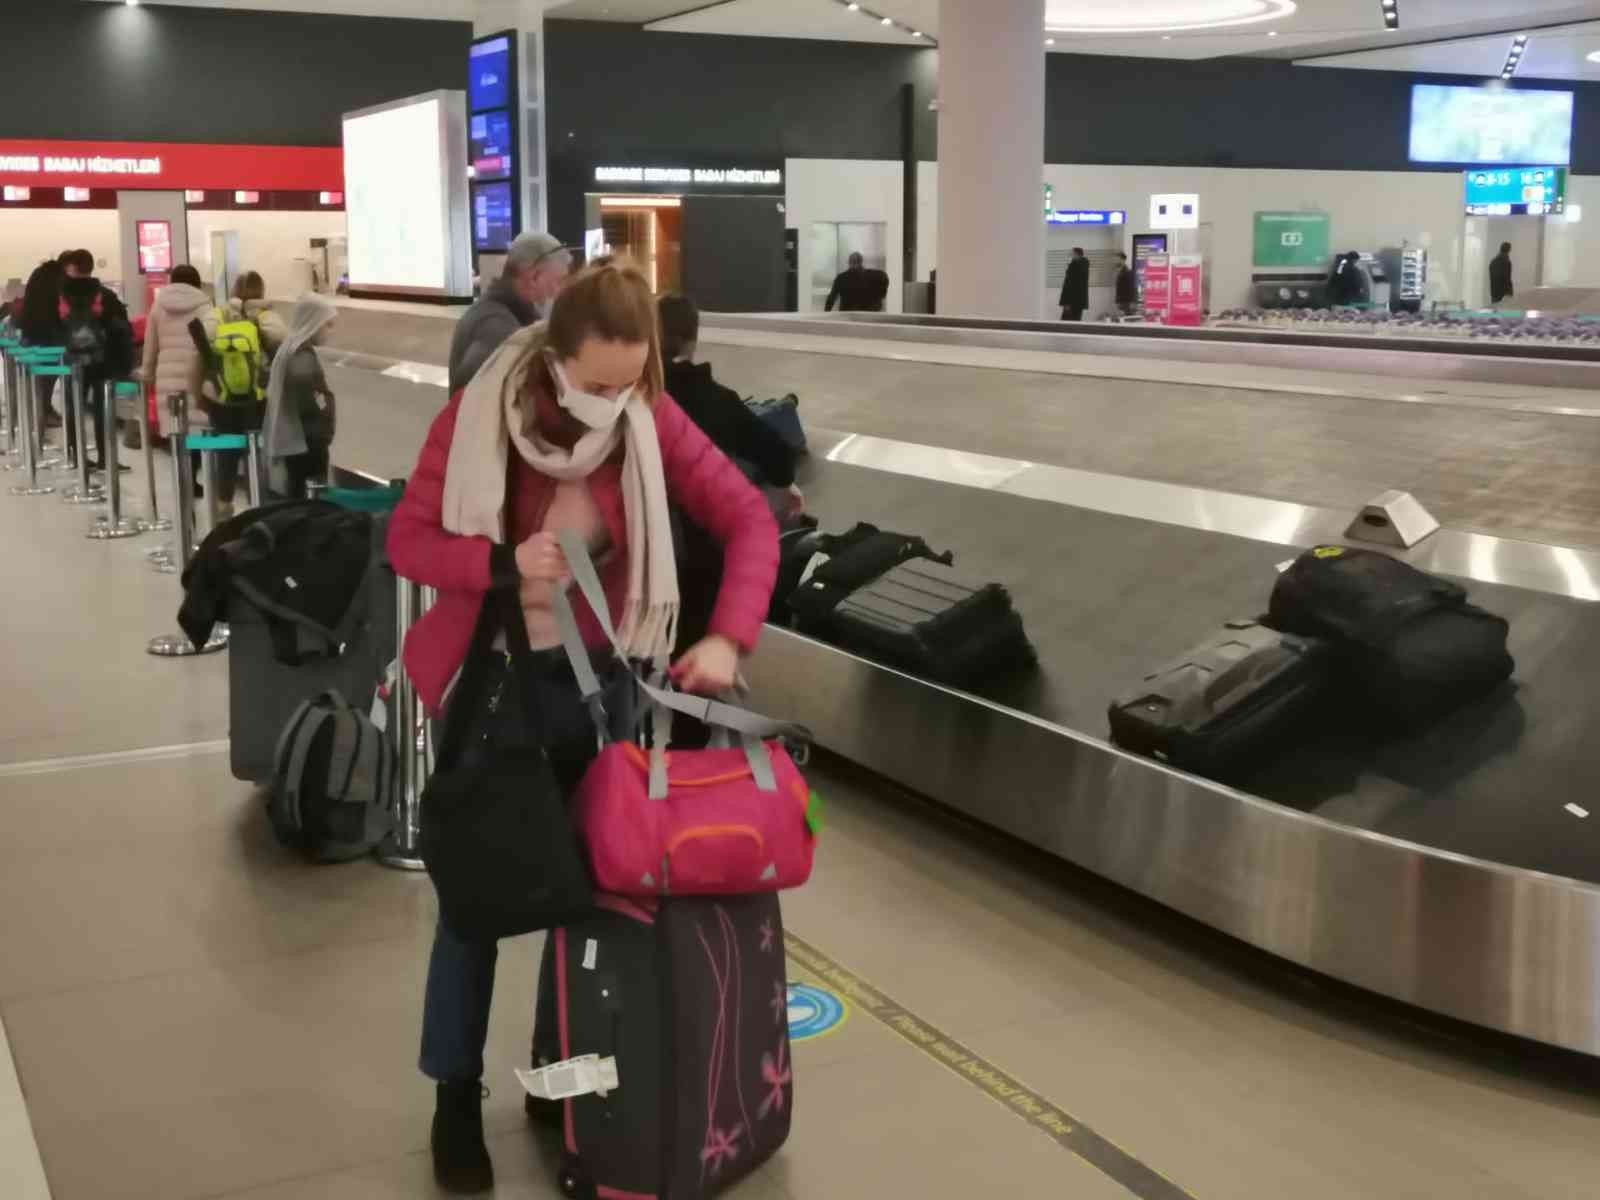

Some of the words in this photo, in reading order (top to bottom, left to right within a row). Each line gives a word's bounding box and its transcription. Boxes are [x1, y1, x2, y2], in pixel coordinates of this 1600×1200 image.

[960, 1060, 1023, 1097] behind
[1010, 1093, 1042, 1114] the
[1036, 1110, 1073, 1136] line
